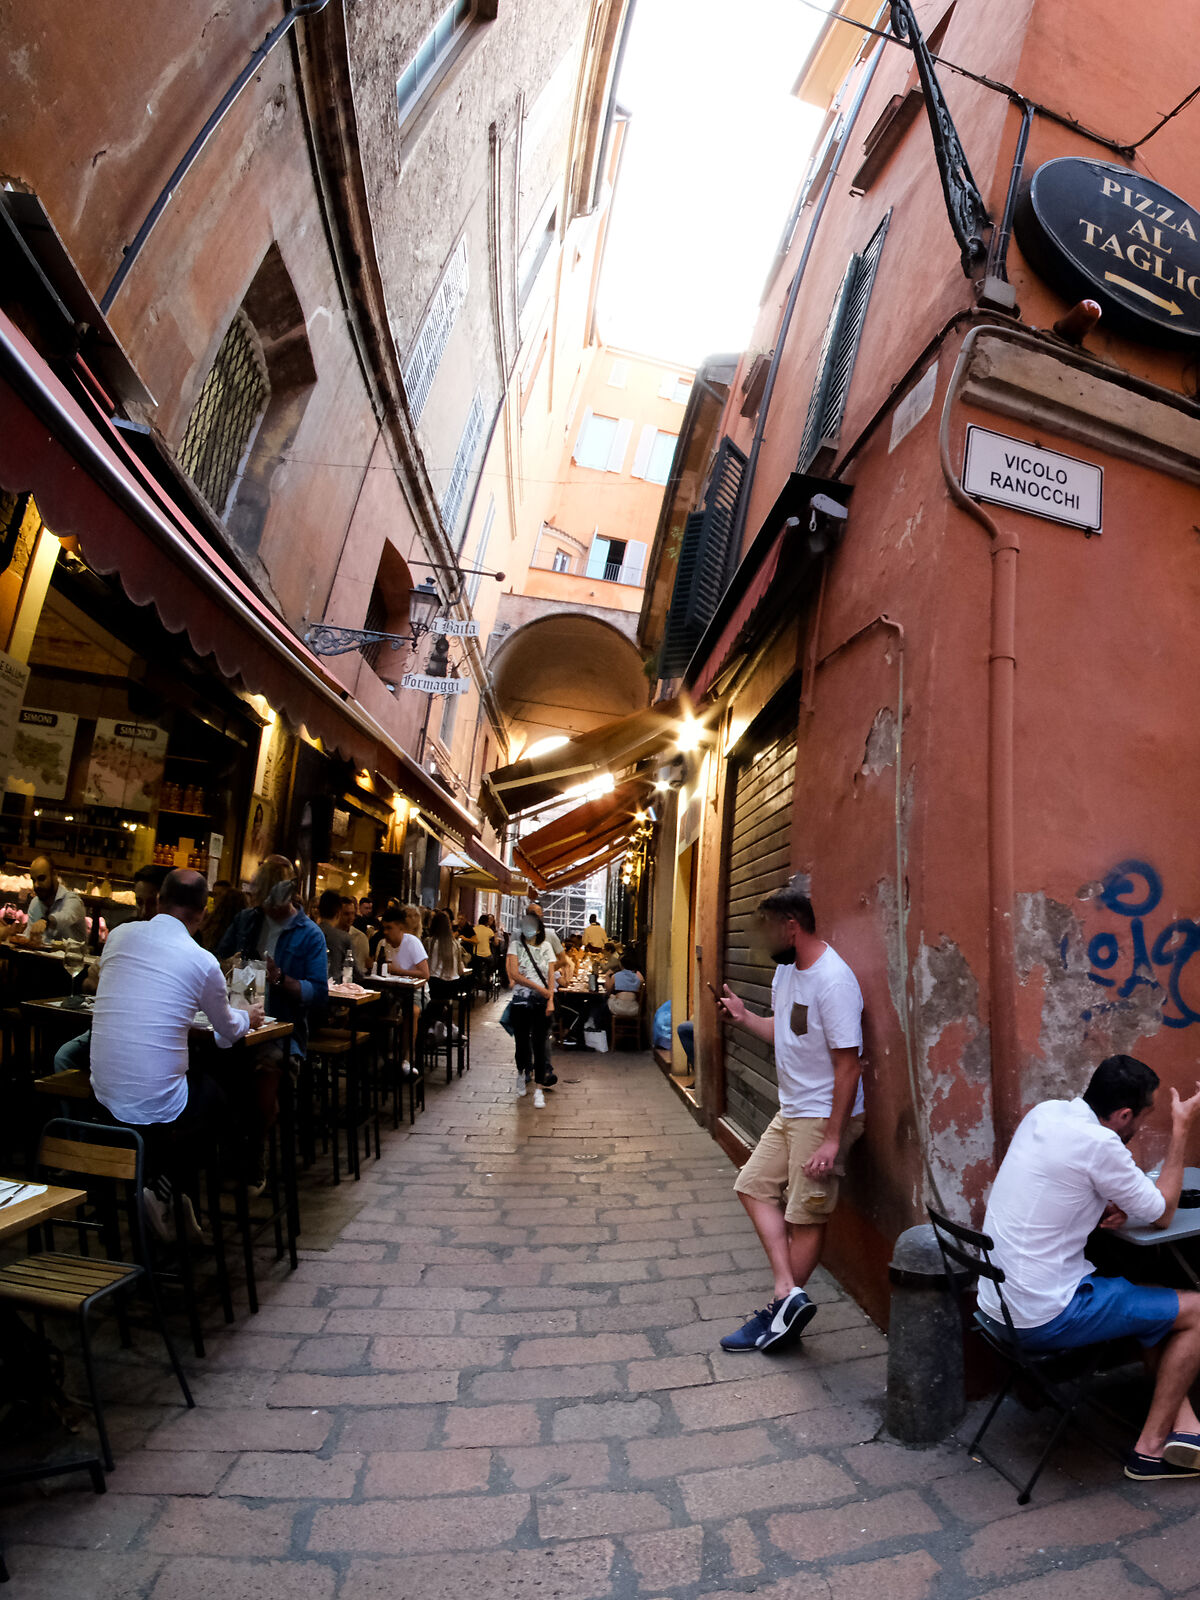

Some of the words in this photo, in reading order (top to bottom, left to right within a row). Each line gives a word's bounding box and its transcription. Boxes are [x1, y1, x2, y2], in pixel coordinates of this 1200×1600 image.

[1099, 176, 1198, 242] PIZZA
[1127, 218, 1173, 255] AL
[1005, 453, 1068, 485] VICOLO
[990, 471, 1080, 510] RANOCCHI
[403, 674, 460, 693] Formaggi
